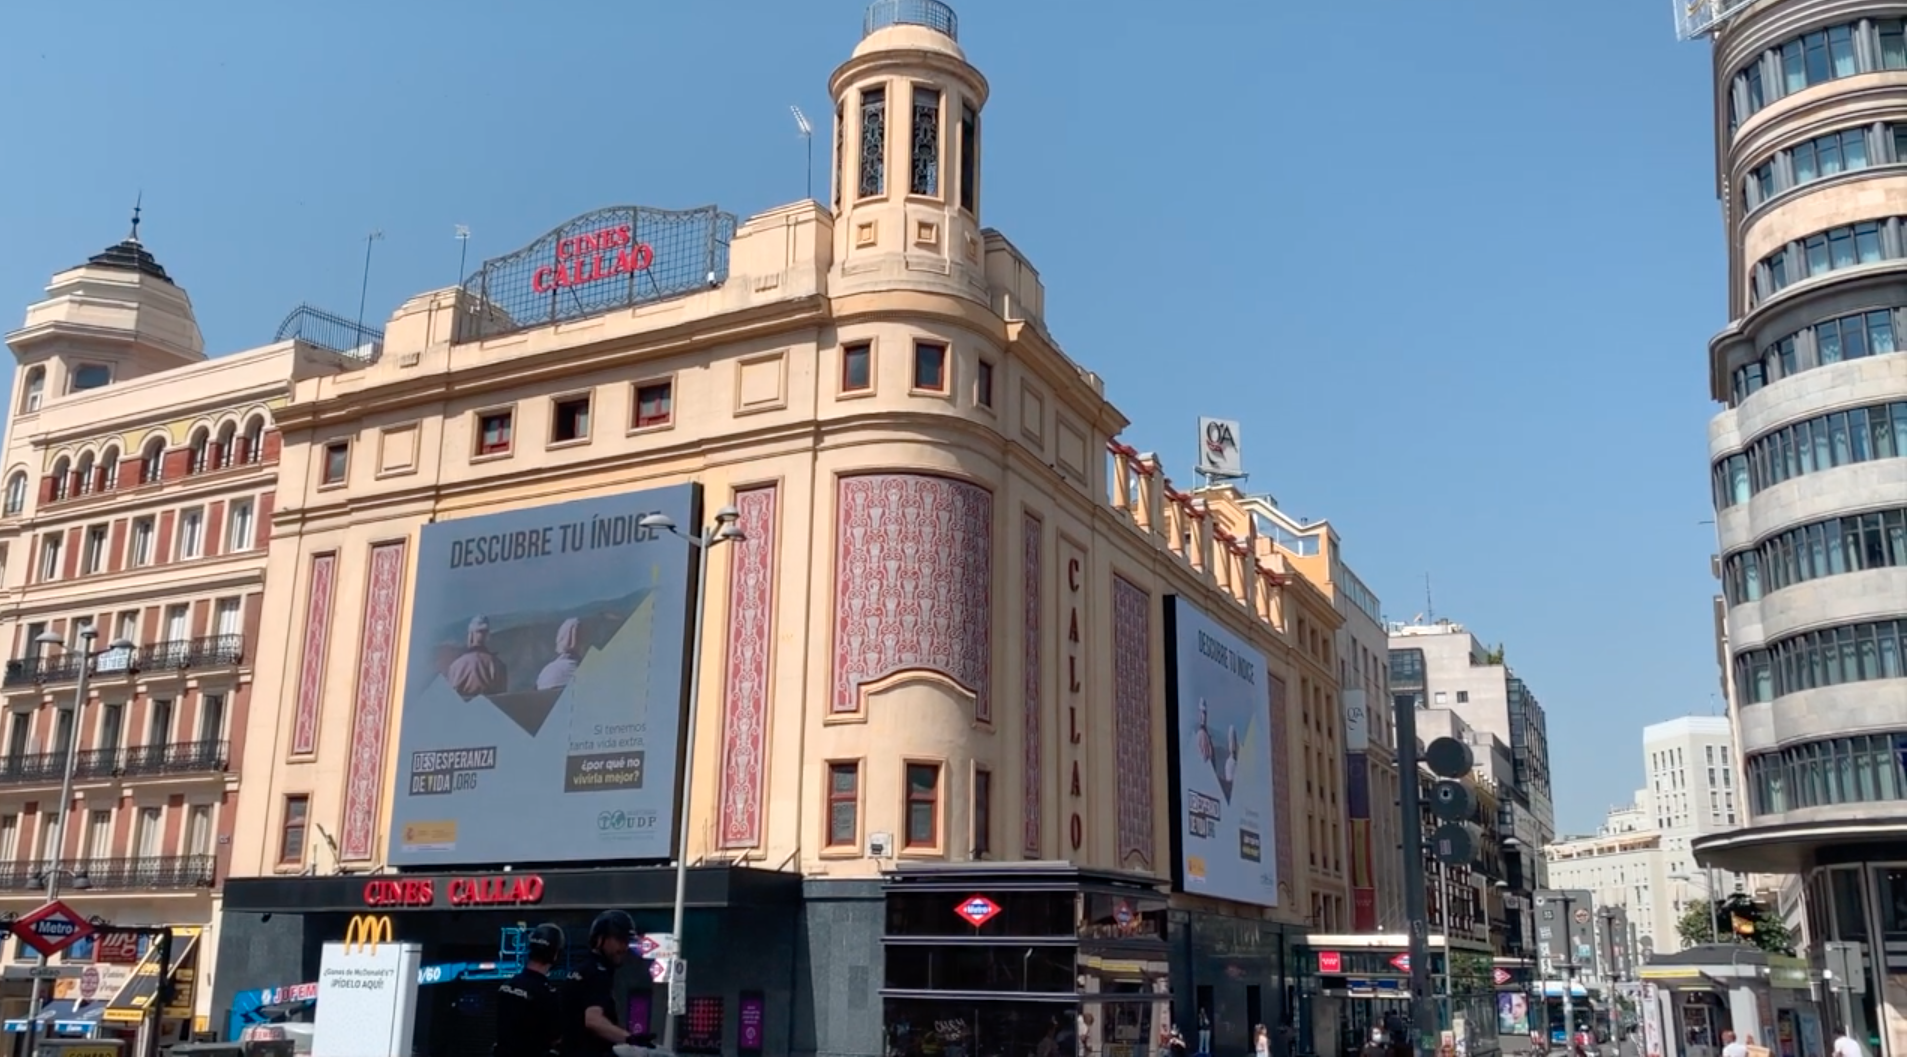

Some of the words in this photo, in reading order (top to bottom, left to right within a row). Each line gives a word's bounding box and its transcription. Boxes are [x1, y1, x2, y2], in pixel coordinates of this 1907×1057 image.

[557, 224, 631, 259] CINES
[532, 243, 654, 293] CALLAO
[450, 526, 554, 569] DESCUBRE
[559, 521, 585, 553] TU
[590, 510, 662, 549] ÍNDICE
[1198, 629, 1229, 669] DESCUBRE
[1229, 649, 1237, 674] TU
[1068, 558, 1082, 850] CALLAO
[605, 723, 647, 735] tenemos
[570, 740, 594, 751] tanta
[597, 737, 617, 748] vida
[606, 756, 626, 771] qué
[627, 758, 641, 768] no
[605, 769, 640, 784] mejor?
[627, 816, 657, 828] UDP
[363, 880, 434, 906] CINES
[447, 874, 544, 904] CALLAO
[38, 921, 74, 935] Metro
[29, 967, 61, 977] Callao
